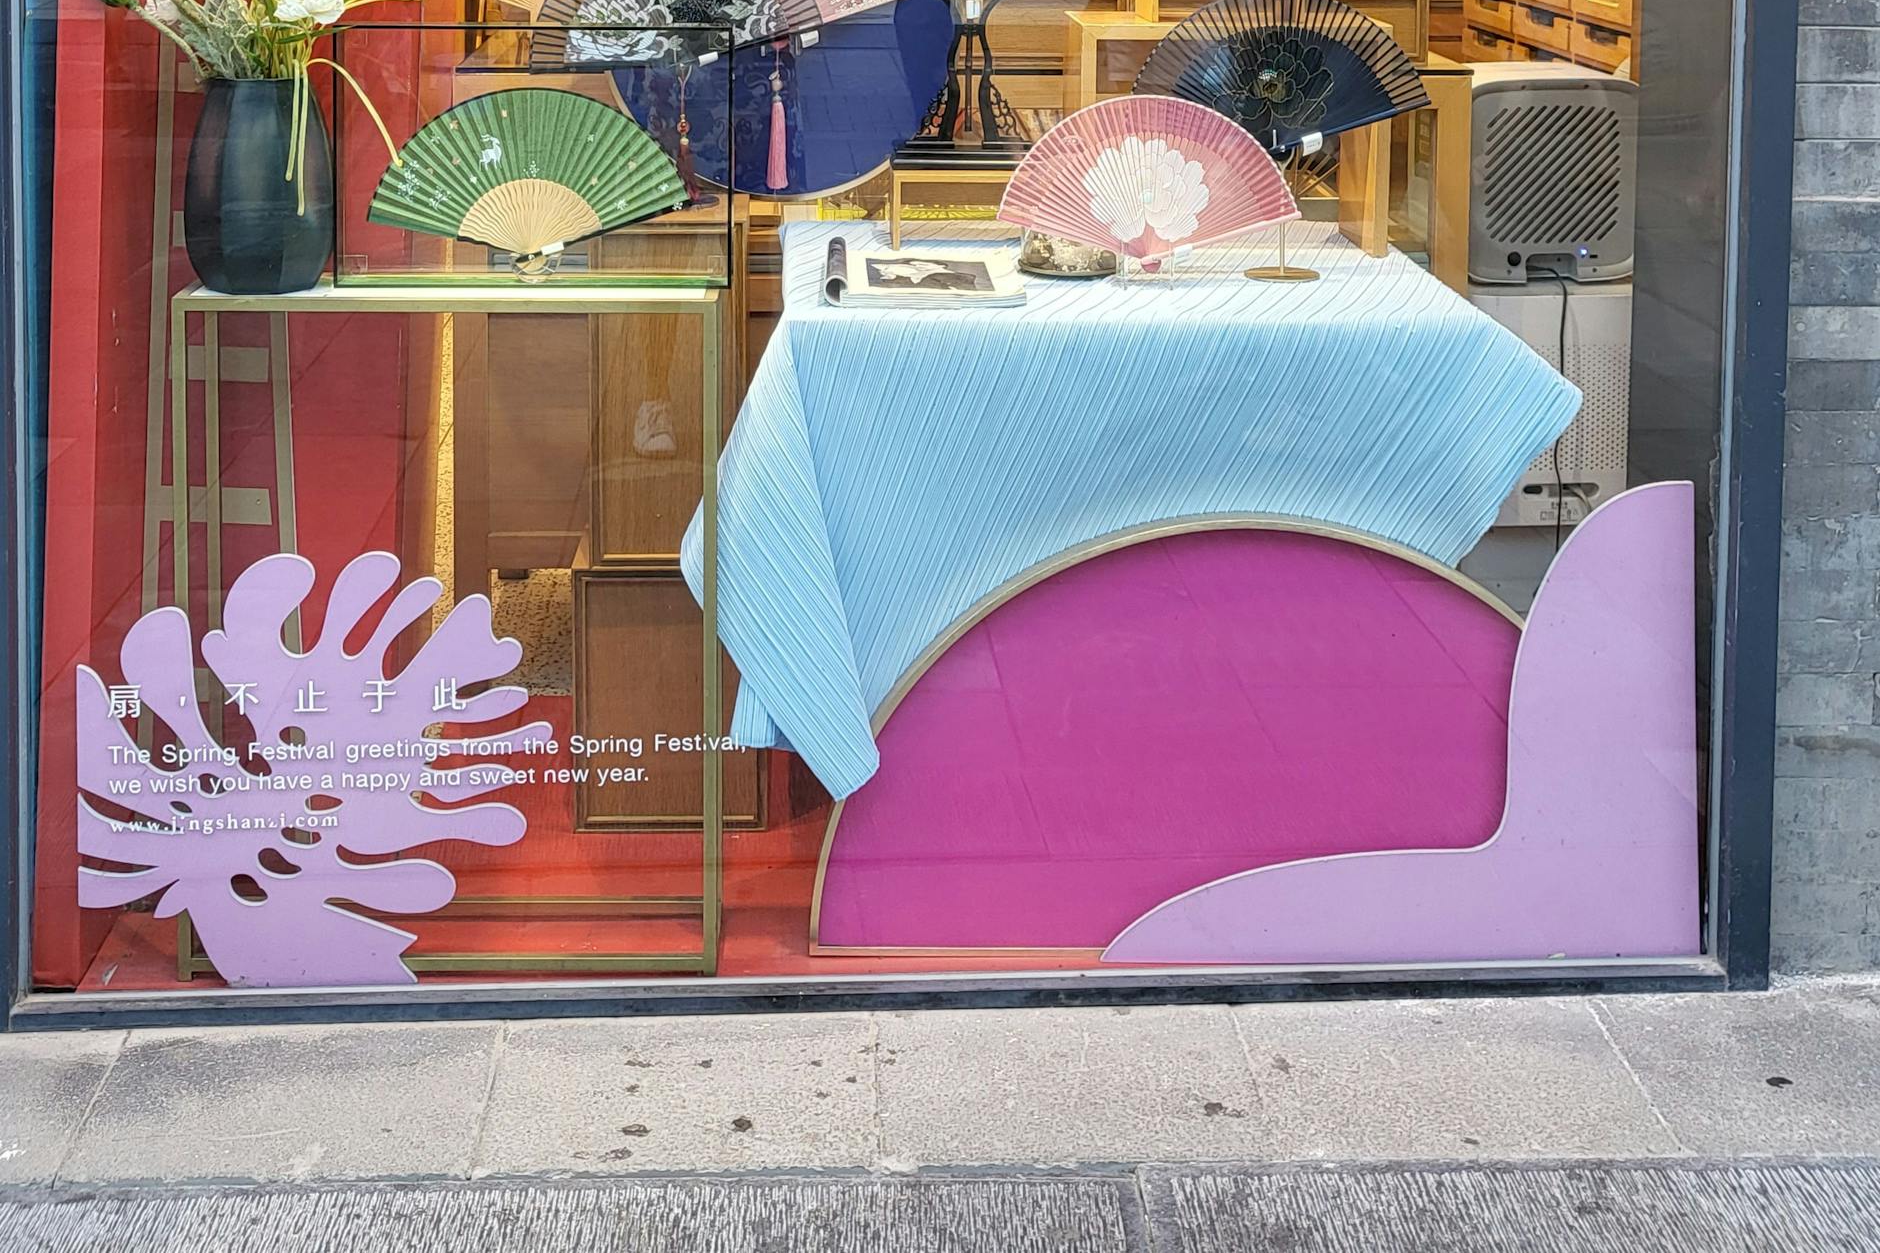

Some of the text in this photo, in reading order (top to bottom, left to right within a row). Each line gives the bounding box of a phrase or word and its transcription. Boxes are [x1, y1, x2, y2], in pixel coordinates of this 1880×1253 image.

[108, 732, 747, 767] The Spring Festival greetings from the Spring Festival,
[109, 767, 649, 796] we wish you have a happy and sweet new year.
